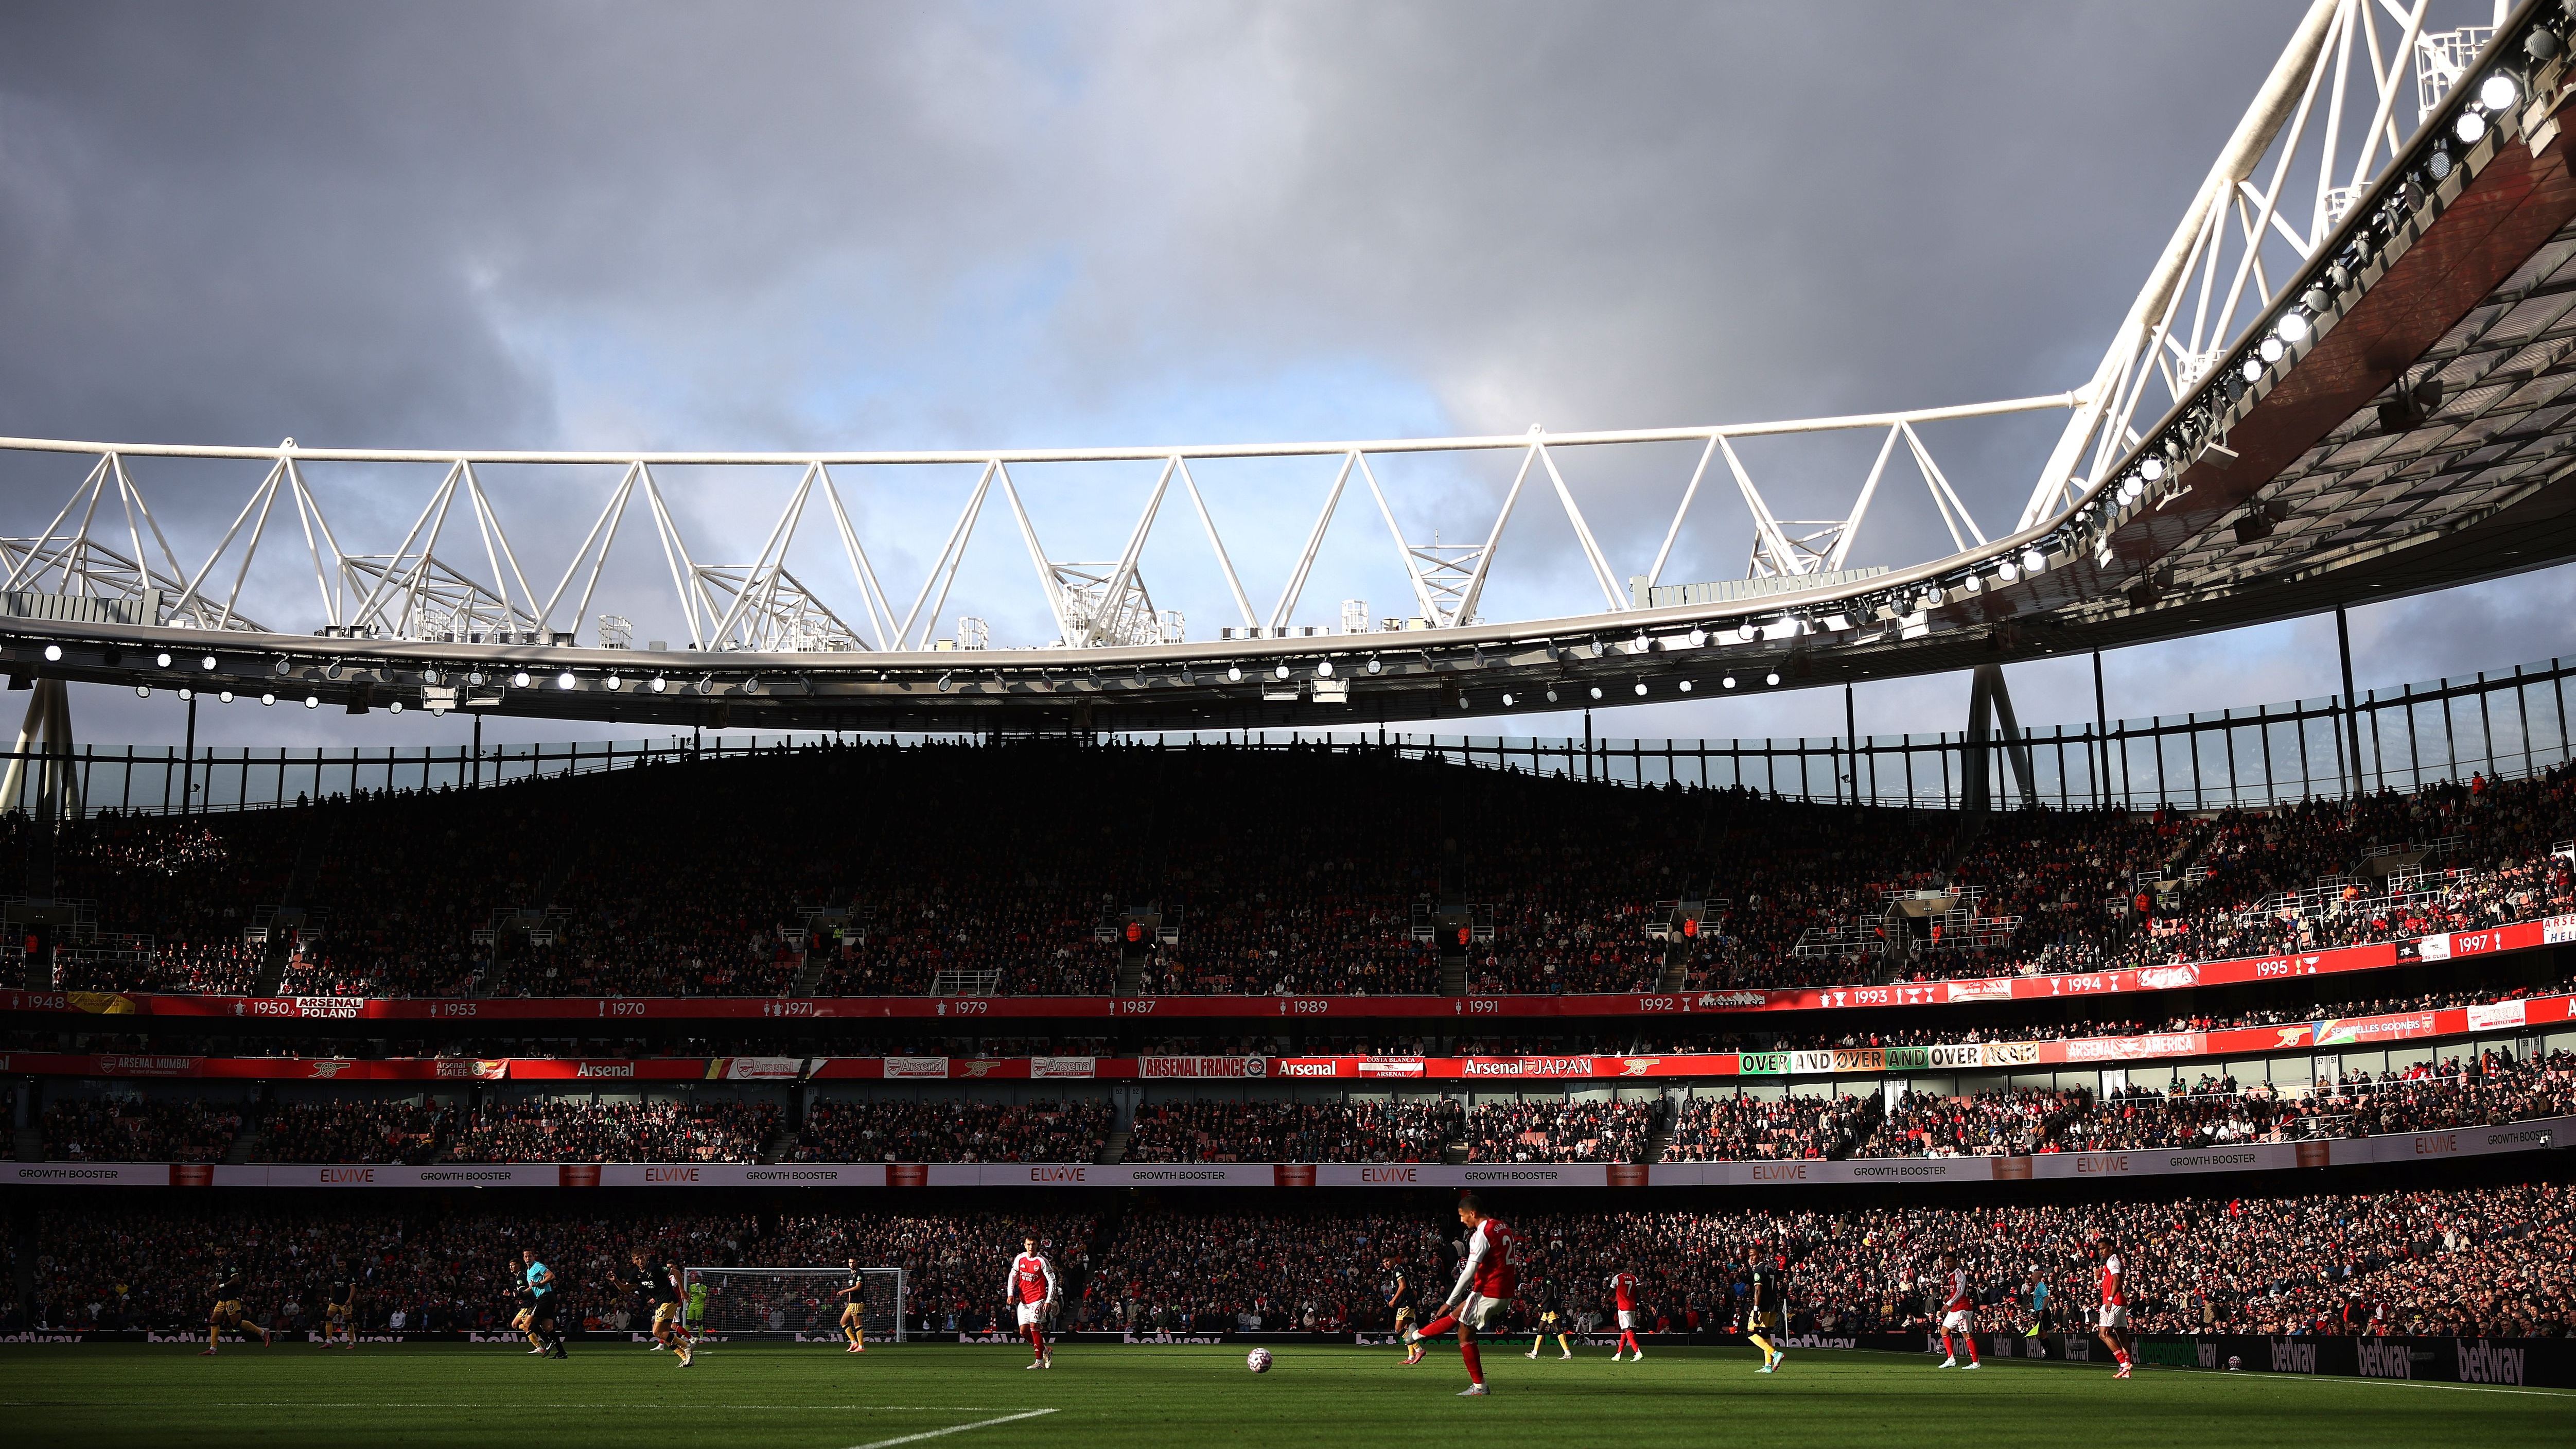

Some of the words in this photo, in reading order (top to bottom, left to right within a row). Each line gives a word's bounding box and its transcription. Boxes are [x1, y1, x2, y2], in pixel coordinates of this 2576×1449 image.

[2545, 916, 2575, 929] ARSE
[2551, 931, 2576, 942] HEL
[2458, 934, 2488, 953] 1997
[2397, 955, 2430, 964] SUPPORTERS
[2256, 959, 2288, 977] 1995
[2067, 976, 2101, 992] 1994
[28, 996, 65, 1009] 1948
[299, 998, 361, 1007] ARSENAL
[1854, 989, 1888, 1004] 1993
[254, 1002, 289, 1015] 1950
[444, 1003, 477, 1016] 1953
[612, 1003, 645, 1015] 1970
[785, 1002, 813, 1015] 1971
[955, 1001, 988, 1014] 1979
[1122, 1001, 1156, 1013] 1987
[1293, 1000, 1328, 1013] 1989
[1469, 1000, 1498, 1012] 1991
[1640, 998, 1674, 1011] 1992
[1700, 1000, 1745, 1009] AUSTRIA
[1750, 999, 1764, 1008] SC
[302, 1008, 357, 1018] POLAND
[2381, 1020, 2420, 1031] GOONERS
[2068, 1041, 2114, 1057] ARSENAL
[2145, 1037, 2193, 1053] AMERICA
[118, 1057, 154, 1068] ARSENAL
[156, 1058, 189, 1069] MUMBAI
[901, 1059, 946, 1071] Arsenal
[1047, 1058, 1094, 1071] Arsenal
[1743, 1055, 1788, 1071] OVER
[1795, 1053, 1831, 1070] AND
[1836, 1051, 1882, 1068] OVER
[1889, 1049, 1925, 1067] AND
[1932, 1047, 1977, 1066] OVER
[577, 1062, 635, 1077] Arsenal
[753, 1061, 793, 1072] Arsenal
[1145, 1058, 1198, 1076] ARSENAL
[1200, 1058, 1246, 1076] FRANCE
[1278, 1060, 1336, 1075] Arsenal
[1464, 1059, 1523, 1075] Arsenal
[1533, 1058, 1591, 1074] JAPAN
[2415, 1134, 2457, 1155] ELVIVE
[2487, 1133, 2518, 1146] GROWTH
[2077, 1156, 2128, 1173] ELVIVE
[2170, 1155, 2211, 1167] GROWTH
[2213, 1153, 2255, 1164] BOOSTER
[19, 1169, 67, 1178] GROWTH
[69, 1169, 118, 1179] BOOSTER
[321, 1169, 374, 1183] ELVIVE
[420, 1172, 463, 1180] GROWTH
[466, 1172, 511, 1180] BOOSTER
[645, 1168, 699, 1182] ELVIVE
[746, 1171, 790, 1180] GROWTH
[792, 1171, 837, 1180] BOOSTER
[1133, 1171, 1177, 1180] GROWTH
[1179, 1171, 1225, 1180] BOOSTER
[1362, 1168, 1417, 1182] ELVIVE
[1465, 1171, 1509, 1180] GROWTH
[1512, 1171, 1557, 1180] BOOSTER
[1753, 1165, 1807, 1180] ELVIVE
[1854, 1167, 1898, 1176] GROWTH
[1901, 1166, 1946, 1176] BOOSTER
[1625, 1281, 1633, 1296] 7
[1993, 1333, 2012, 1357] betway
[2270, 1336, 2316, 1374] betway
[2356, 1337, 2411, 1380] betway
[2457, 1338, 2524, 1386] betway
